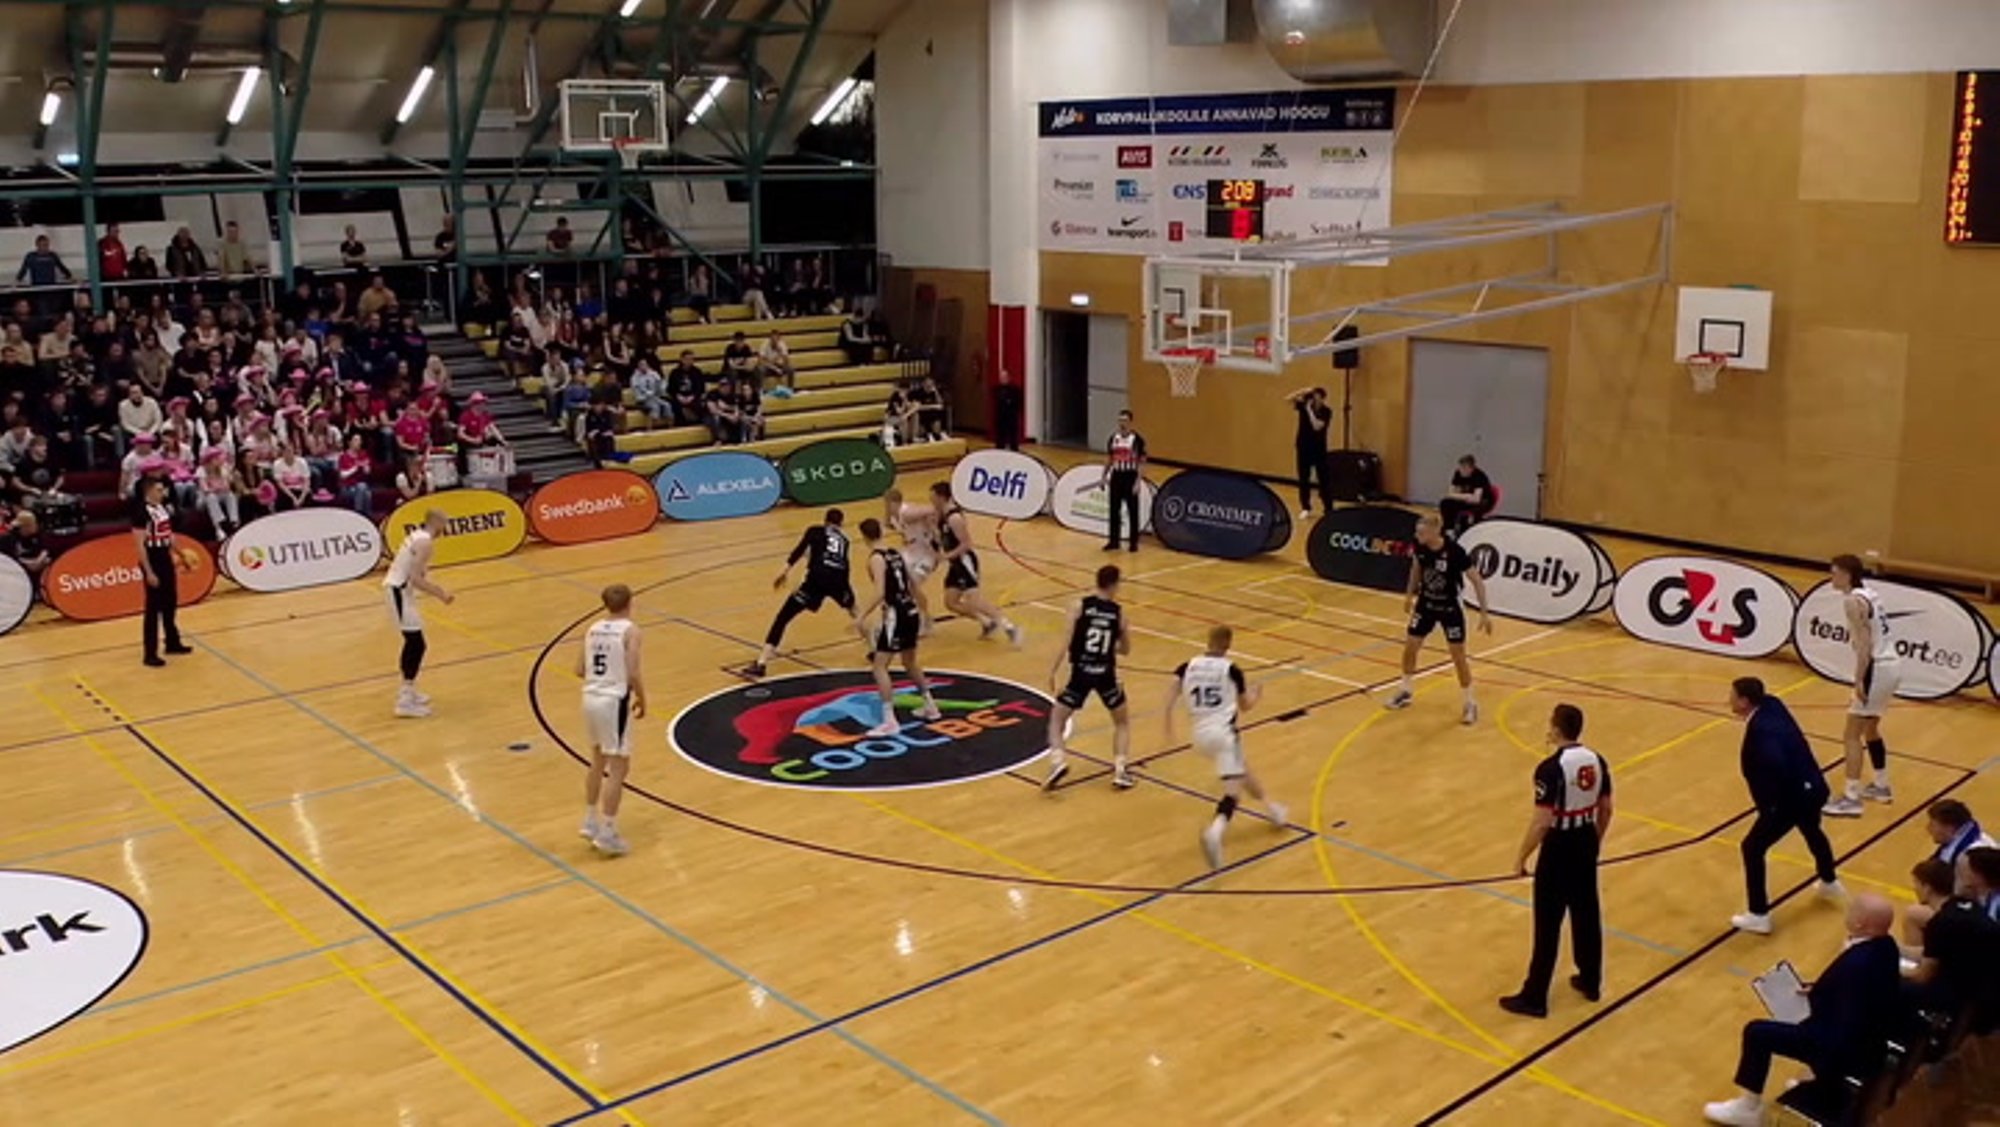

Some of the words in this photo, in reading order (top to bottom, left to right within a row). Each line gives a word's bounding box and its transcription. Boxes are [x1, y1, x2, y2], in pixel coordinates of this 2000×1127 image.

[1279, 105, 1330, 119] HOOGU
[1121, 151, 1148, 164] AVIS
[1173, 184, 1205, 200] ENS
[697, 476, 775, 496] ALEXELA
[969, 466, 1027, 500] Delfi
[540, 493, 625, 520] Swedbank
[1187, 501, 1265, 526] CRONIMET
[268, 531, 373, 566] UTILITAS
[58, 565, 142, 593] Swedba
[1503, 553, 1579, 597] Daily
[1648, 567, 1759, 646] G4S
[1085, 626, 1111, 655] 21
[1809, 615, 1964, 670] teaort.ee
[593, 653, 608, 677] 5
[1189, 684, 1224, 708] 15
[770, 699, 1046, 782] COOLBET
[0, 910, 108, 957] rk
